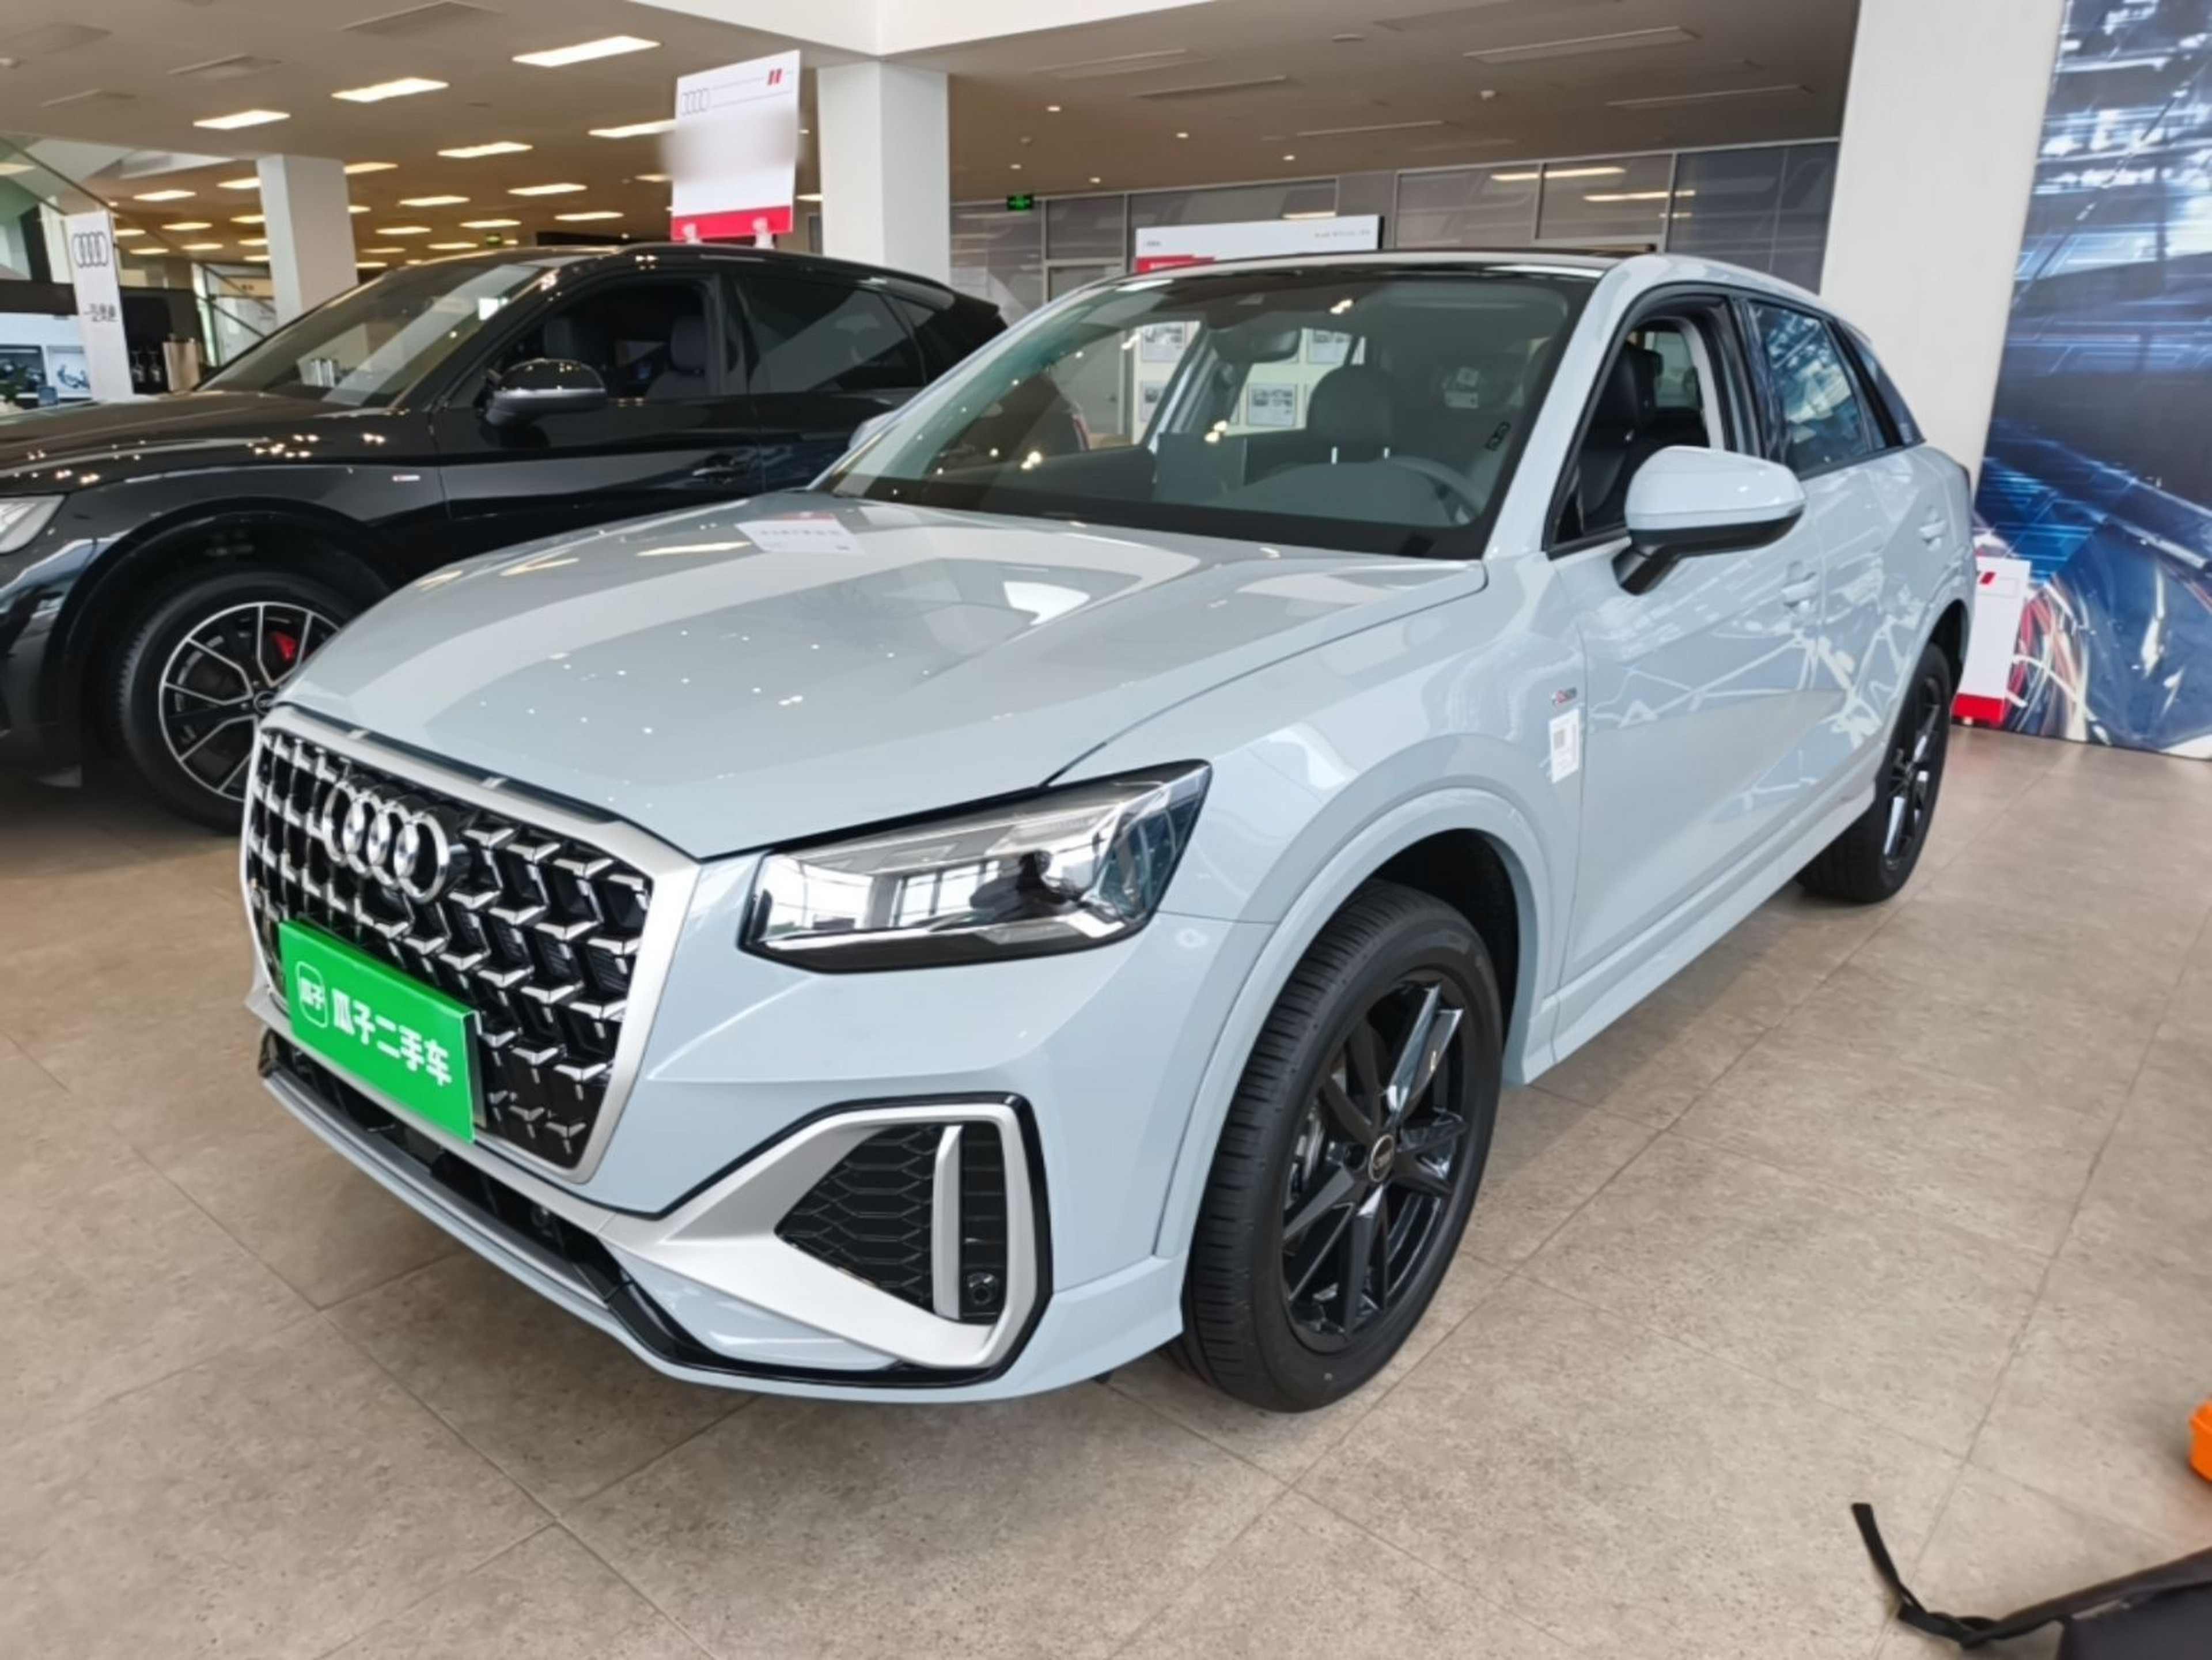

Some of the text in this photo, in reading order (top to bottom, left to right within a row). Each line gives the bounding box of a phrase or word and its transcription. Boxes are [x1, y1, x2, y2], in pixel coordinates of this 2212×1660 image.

[331, 988, 452, 1086] 瓜子二手车
